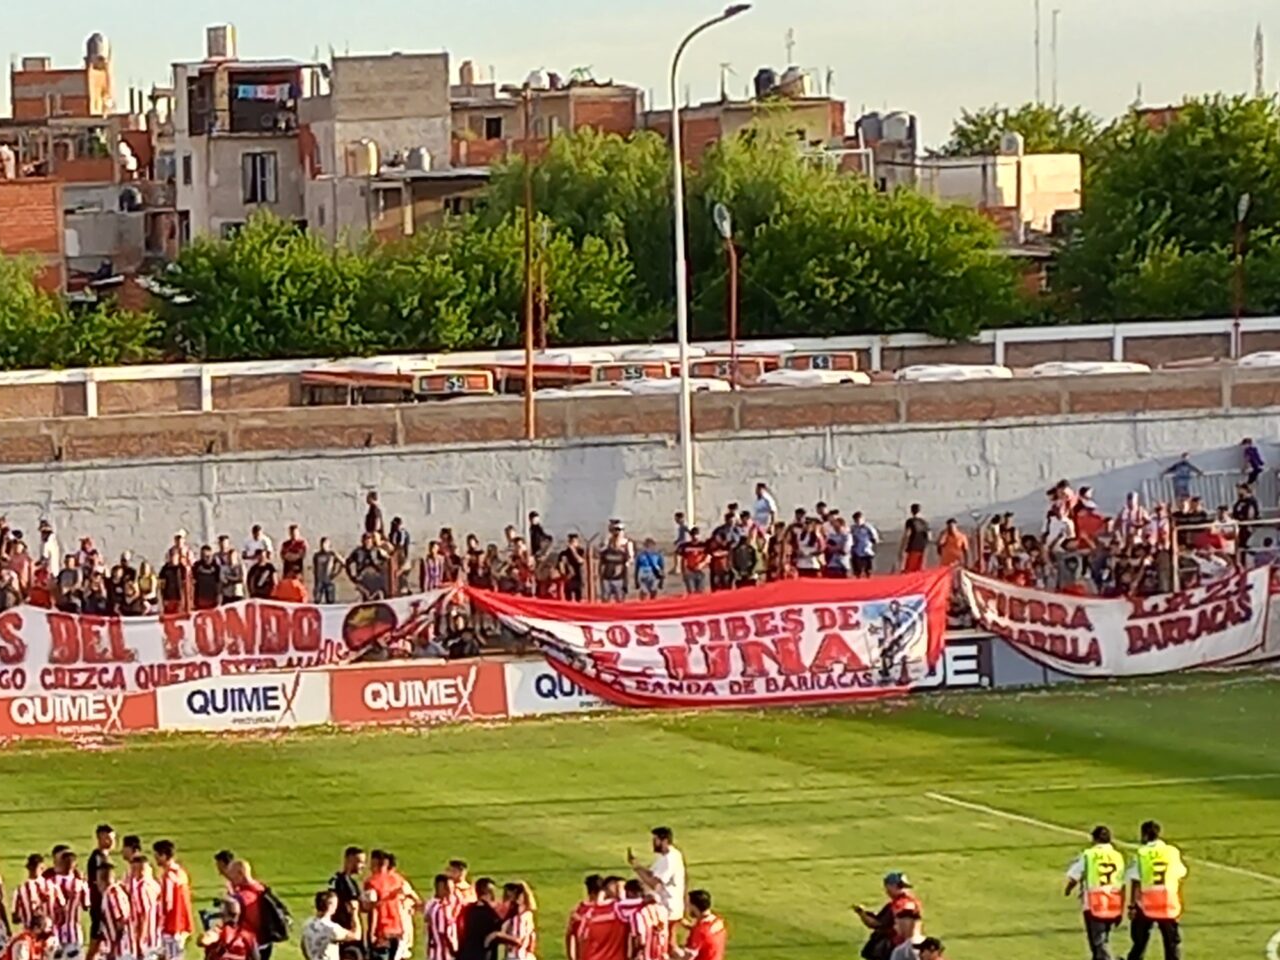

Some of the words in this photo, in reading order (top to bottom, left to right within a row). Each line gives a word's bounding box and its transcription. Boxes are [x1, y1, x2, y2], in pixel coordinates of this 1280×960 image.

[47, 612, 135, 664] DEL
[160, 603, 321, 660] FONDO
[580, 624, 660, 648] LOS
[682, 607, 805, 644] PIBES
[814, 605, 861, 631] DE
[1124, 594, 1252, 655] BARRACAS
[40, 664, 126, 690] CREZCA
[135, 661, 212, 689] QUIERO
[187, 671, 300, 722] QUIMEX
[364, 666, 477, 720] QUIMEX
[635, 680, 718, 696] BANDA
[729, 679, 756, 695] DE
[766, 672, 873, 694] BARRACAS
[10, 694, 123, 734] QUIMEX
